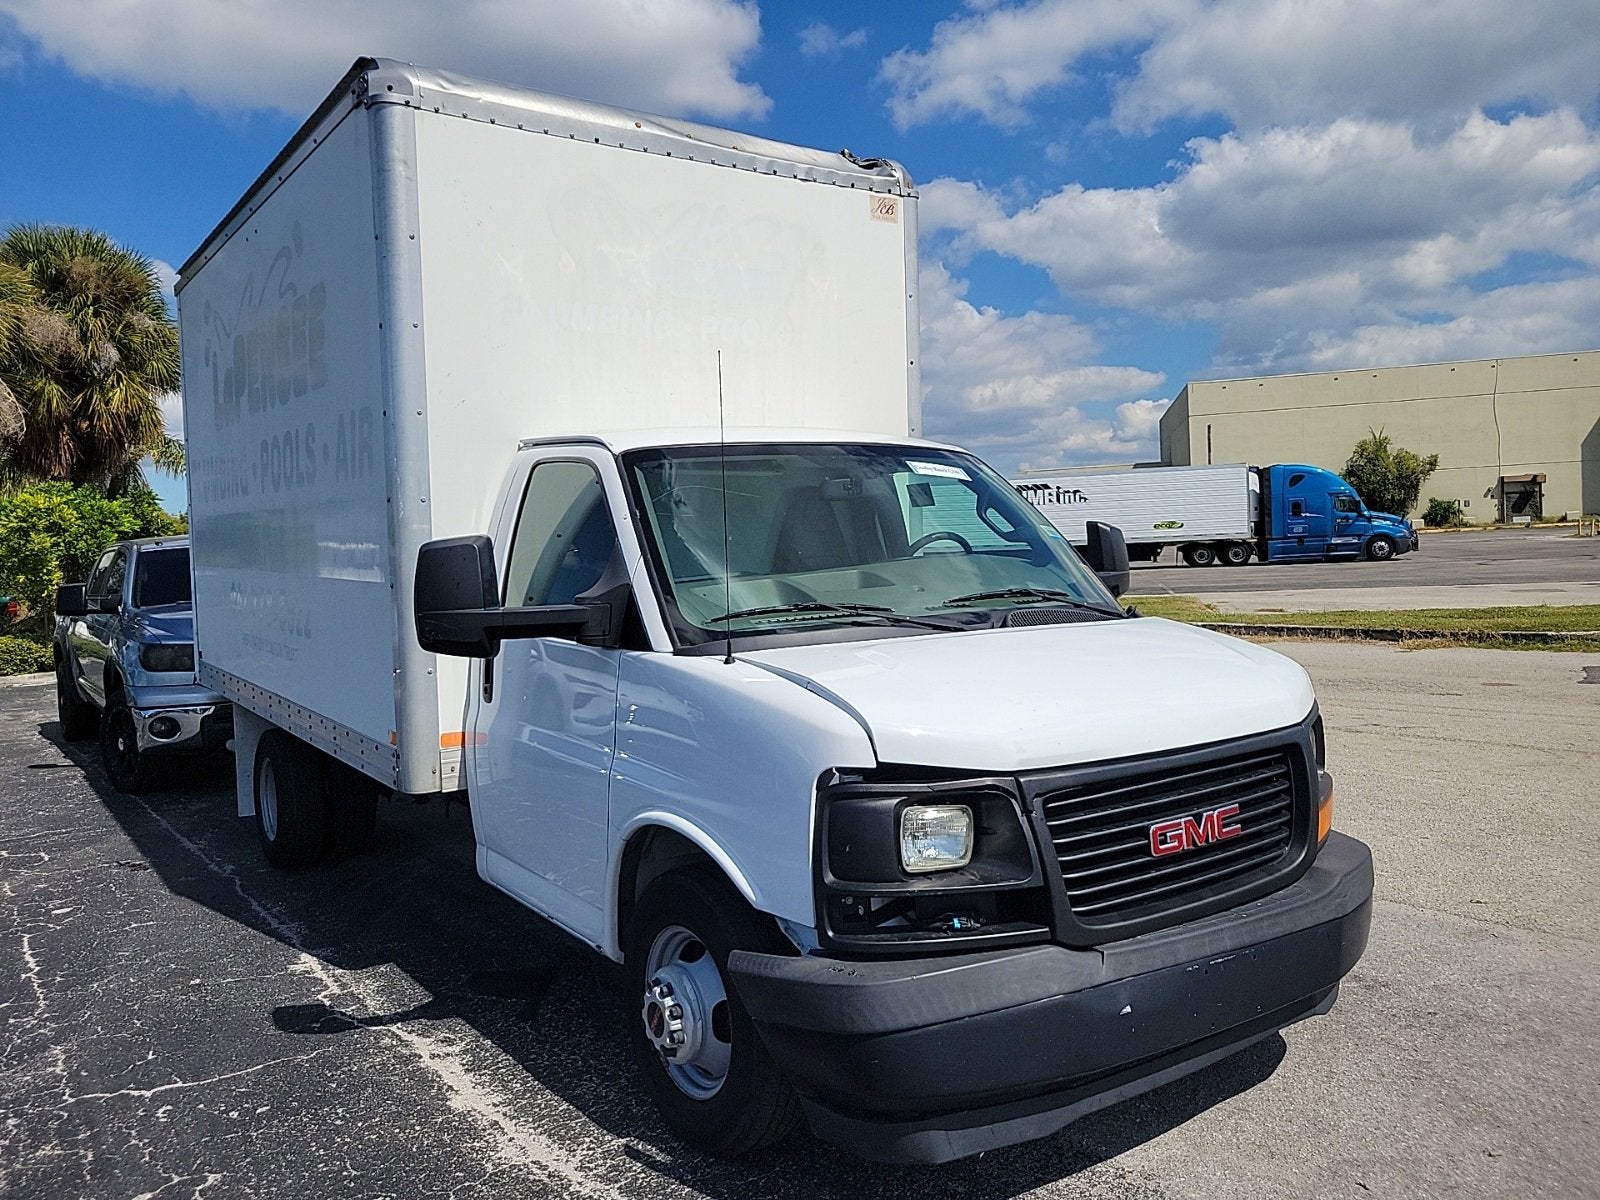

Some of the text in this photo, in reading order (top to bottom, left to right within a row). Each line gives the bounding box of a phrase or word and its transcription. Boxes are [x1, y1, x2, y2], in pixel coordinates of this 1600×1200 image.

[260, 422, 316, 494] POOLS
[335, 406, 374, 483] AIR
[1056, 486, 1089, 504] inc.
[1149, 803, 1242, 857] GMC
